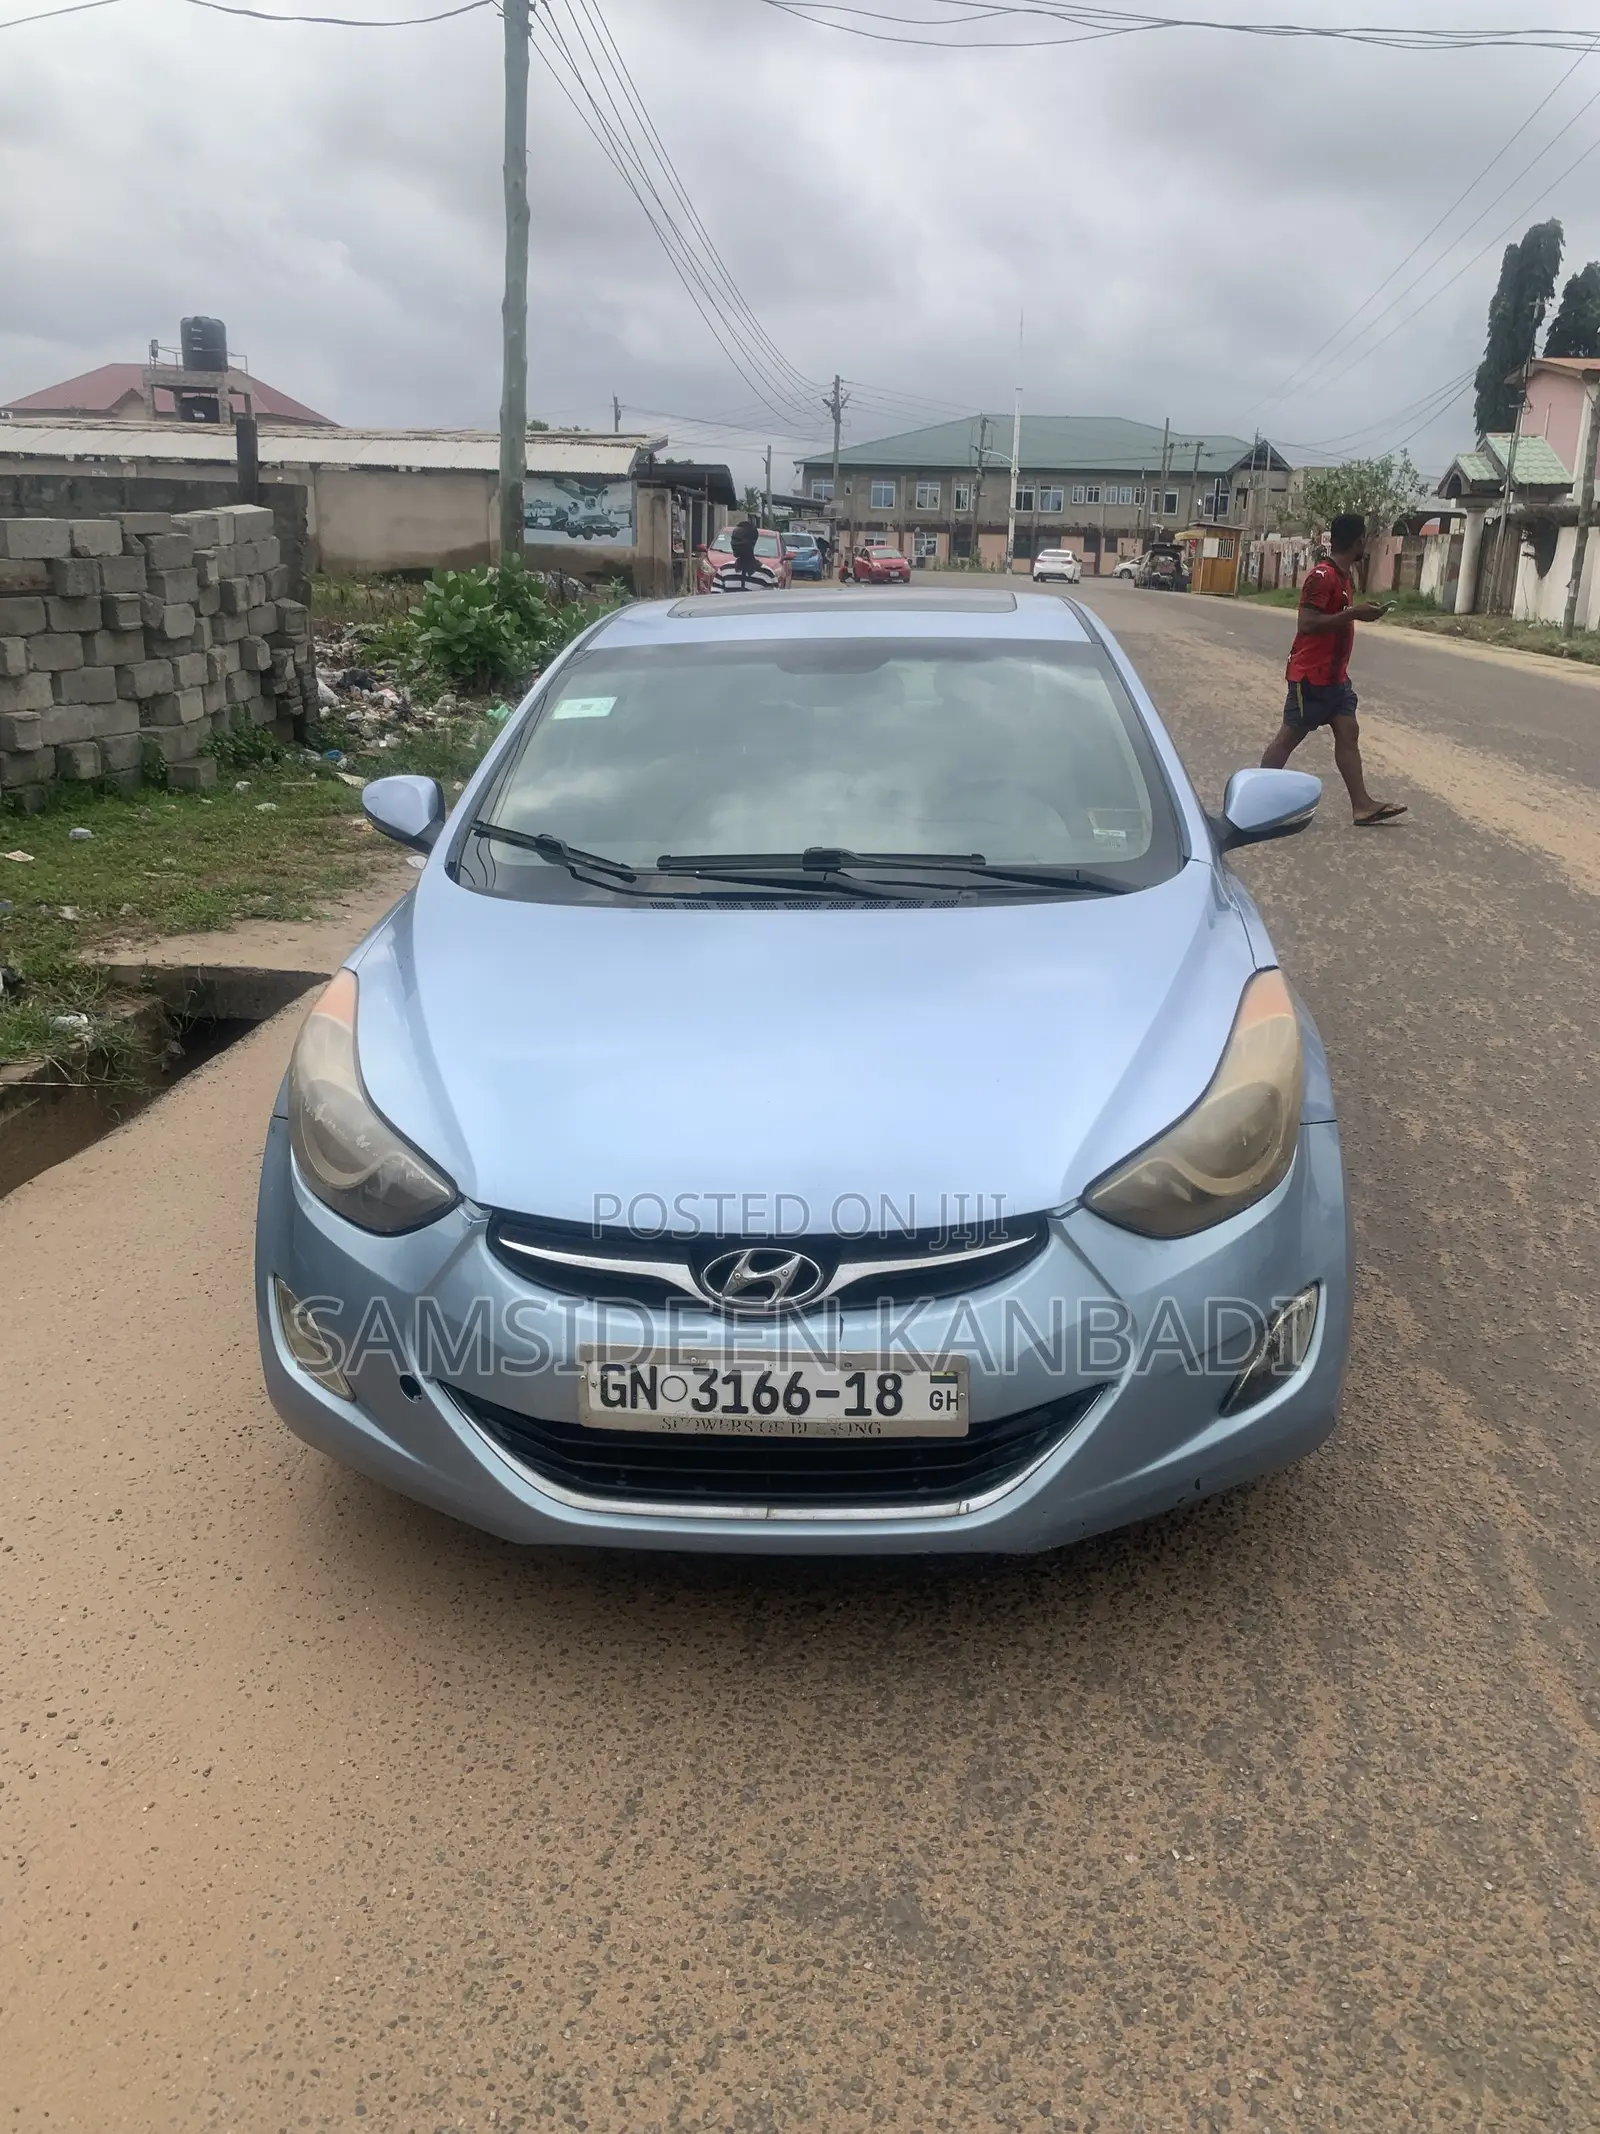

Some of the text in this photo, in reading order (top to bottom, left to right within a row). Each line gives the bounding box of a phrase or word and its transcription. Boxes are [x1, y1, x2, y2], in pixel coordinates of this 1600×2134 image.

[600, 1363, 903, 1417] GN 3166-18
[929, 1390, 959, 1412] GH
